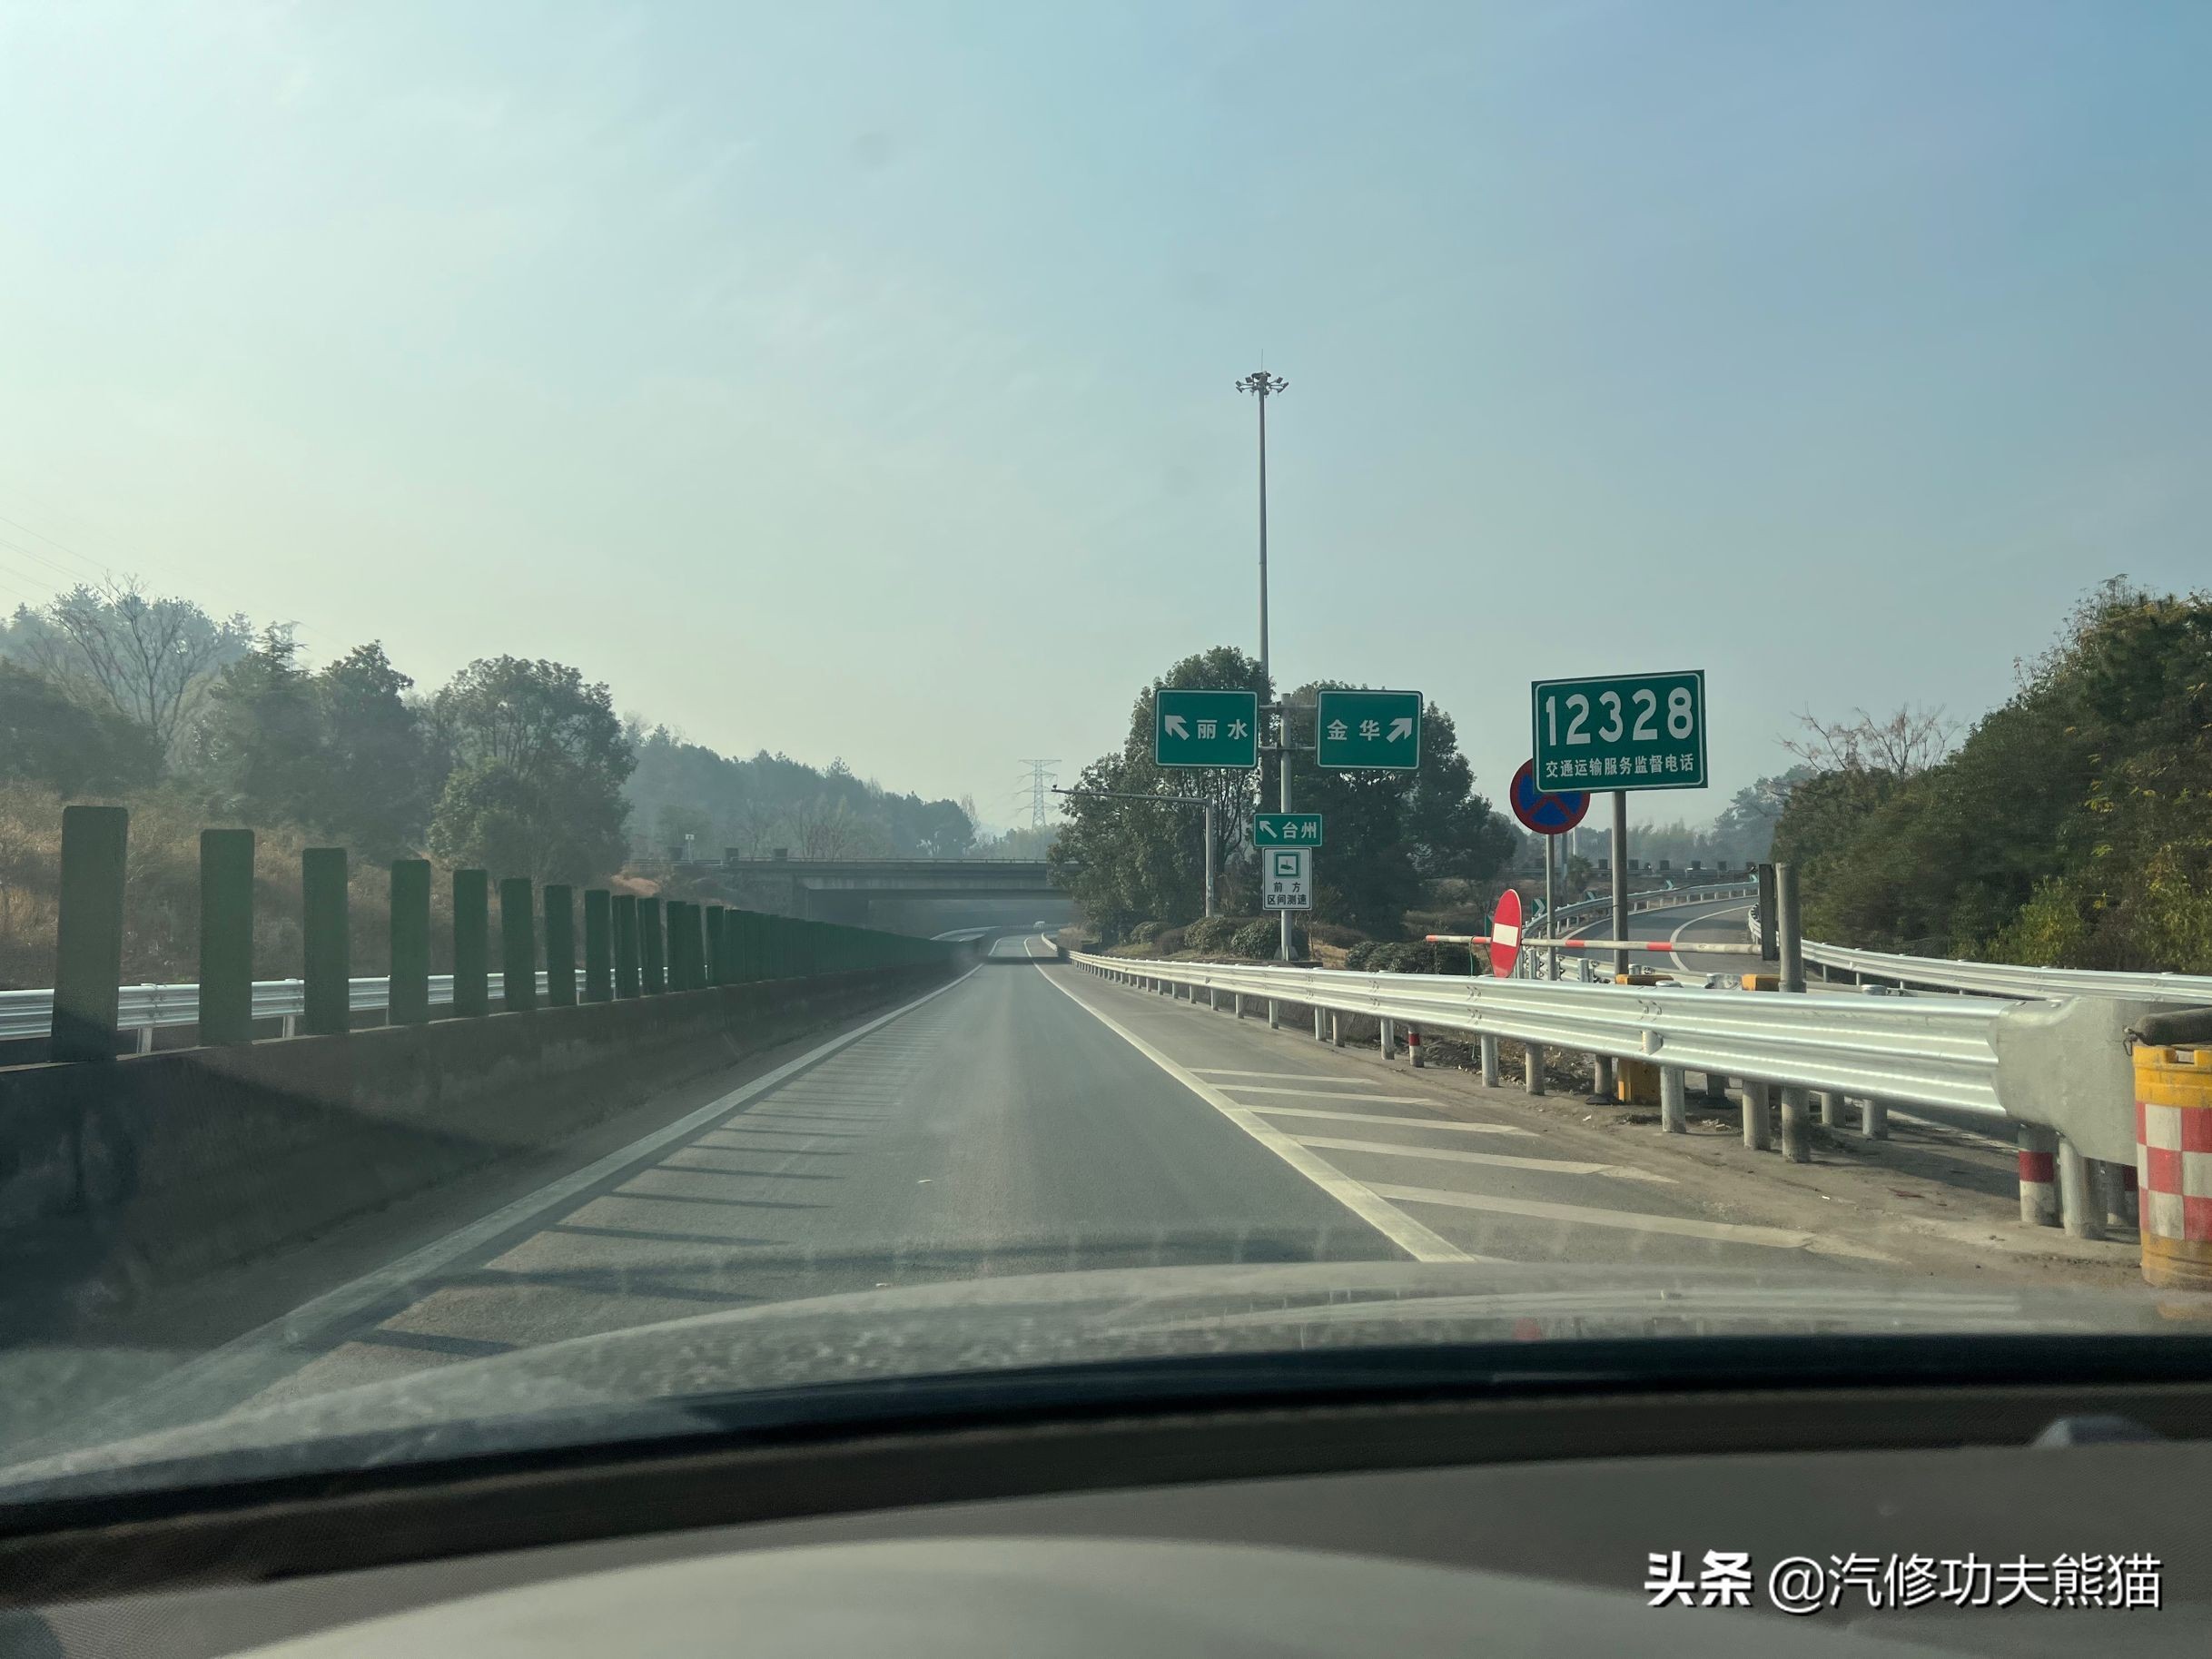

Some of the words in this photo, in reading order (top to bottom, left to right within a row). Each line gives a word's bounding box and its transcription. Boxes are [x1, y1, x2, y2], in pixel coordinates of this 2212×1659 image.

[1545, 686, 1694, 746] 12328
[1196, 718, 1249, 740] 丽水
[1327, 719, 1381, 742] 金华
[1545, 753, 1694, 778] 交通运输服务监督电话
[1281, 821, 1317, 839] 台州
[1273, 882, 1301, 893] 前方
[1267, 894, 1308, 905] 区间测速
